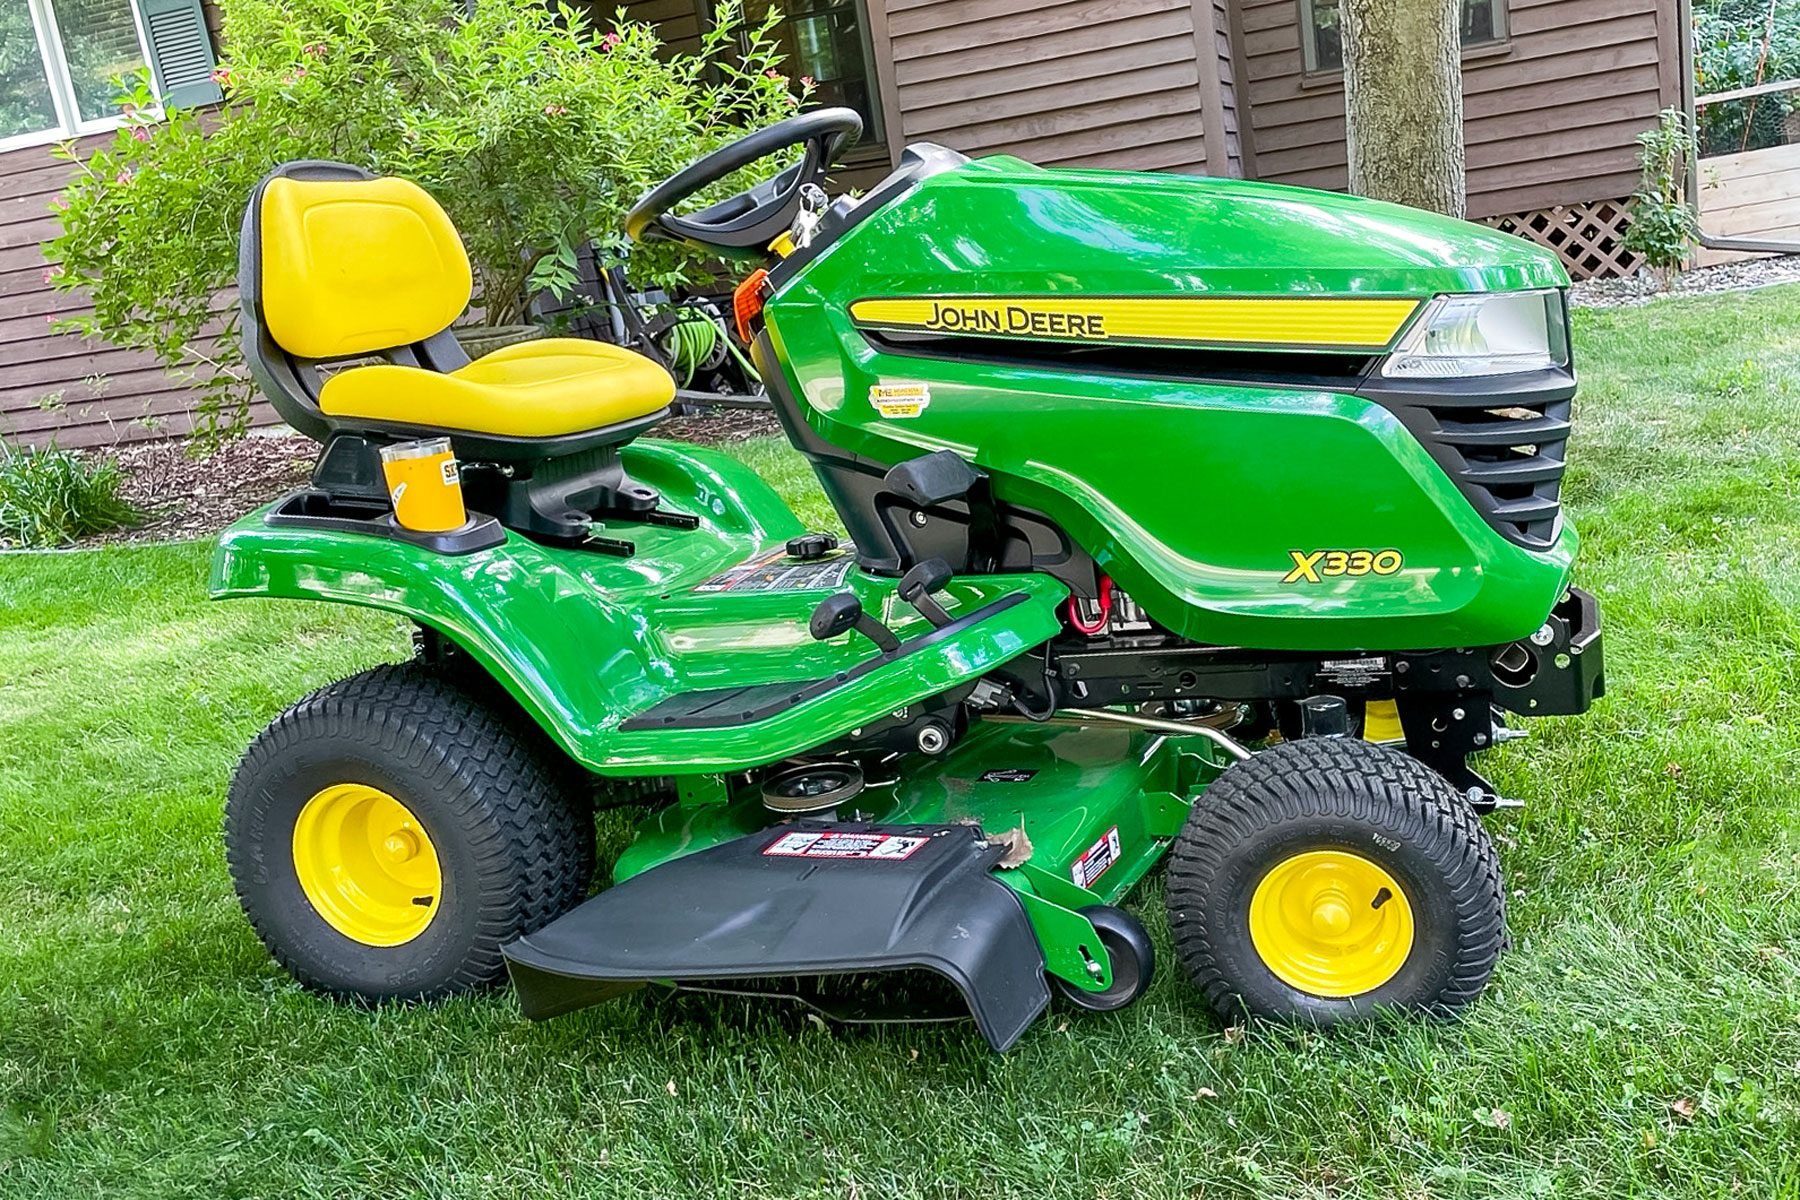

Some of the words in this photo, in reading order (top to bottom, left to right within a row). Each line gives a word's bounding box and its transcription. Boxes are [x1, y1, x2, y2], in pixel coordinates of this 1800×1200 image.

[926, 302, 1001, 330] JOHN
[1007, 306, 1106, 336] DEERE
[1281, 549, 1404, 584] X330
